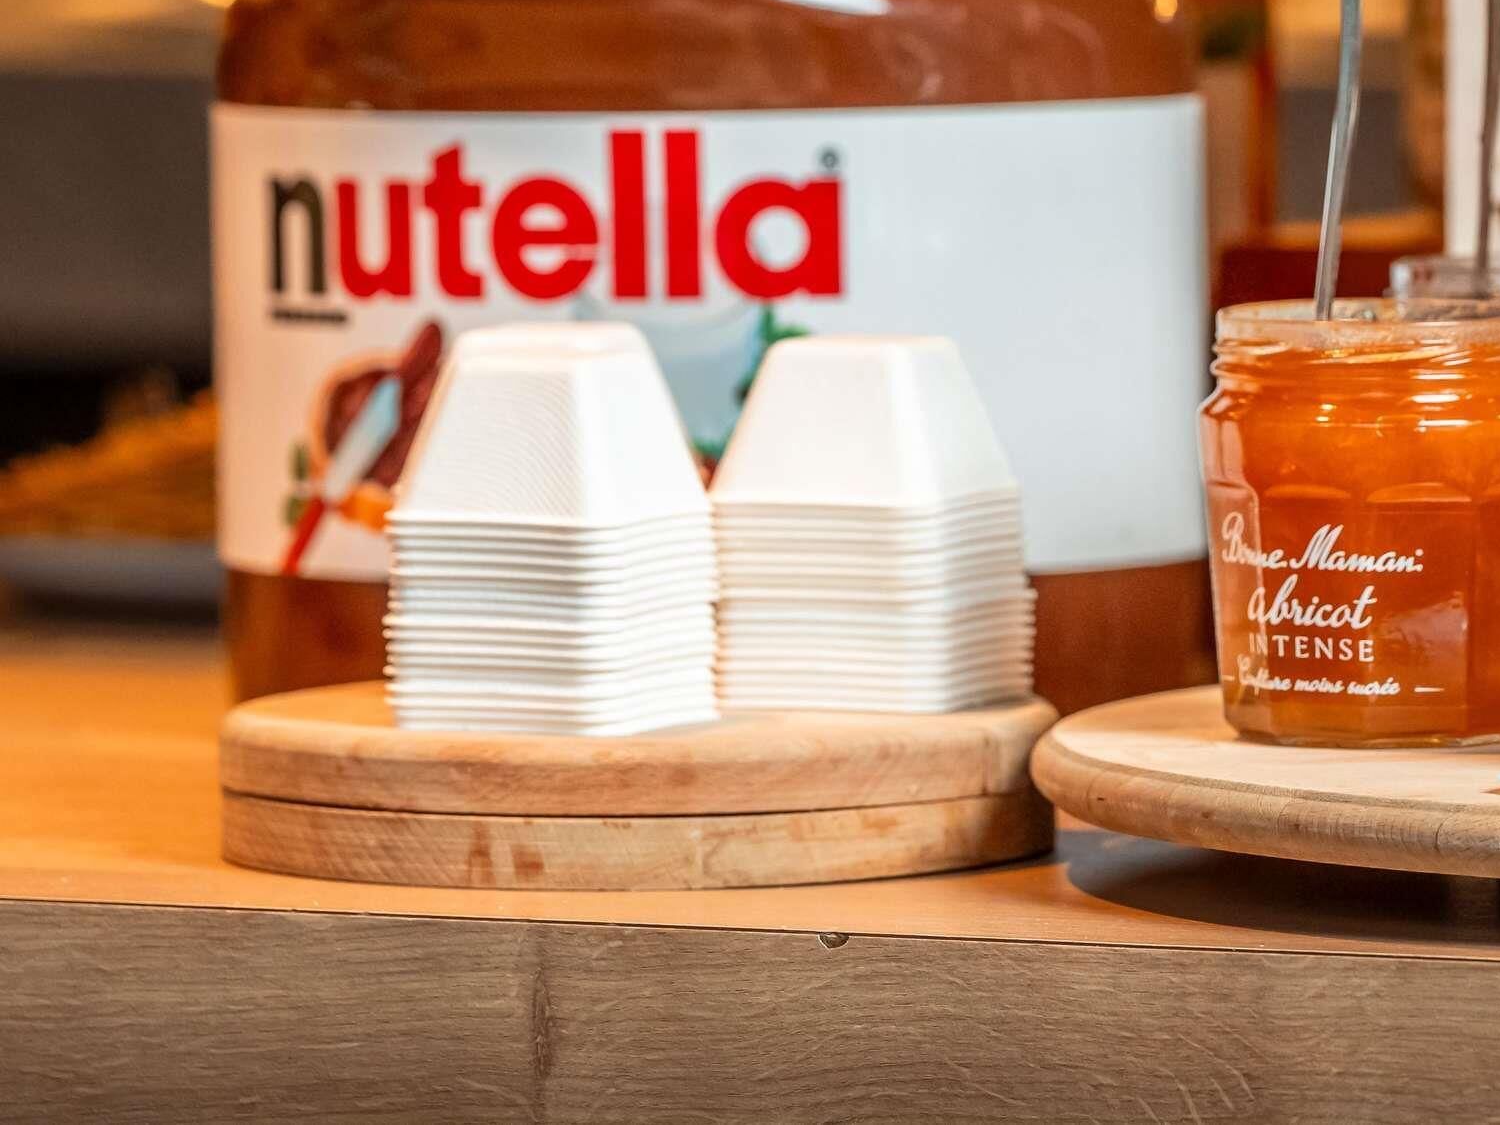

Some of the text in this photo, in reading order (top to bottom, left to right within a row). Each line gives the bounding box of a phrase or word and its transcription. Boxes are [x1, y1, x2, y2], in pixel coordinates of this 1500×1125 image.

[270, 130, 843, 301] nutella
[1289, 524, 1424, 572] Maman
[1249, 631, 1375, 662] INTENSE
